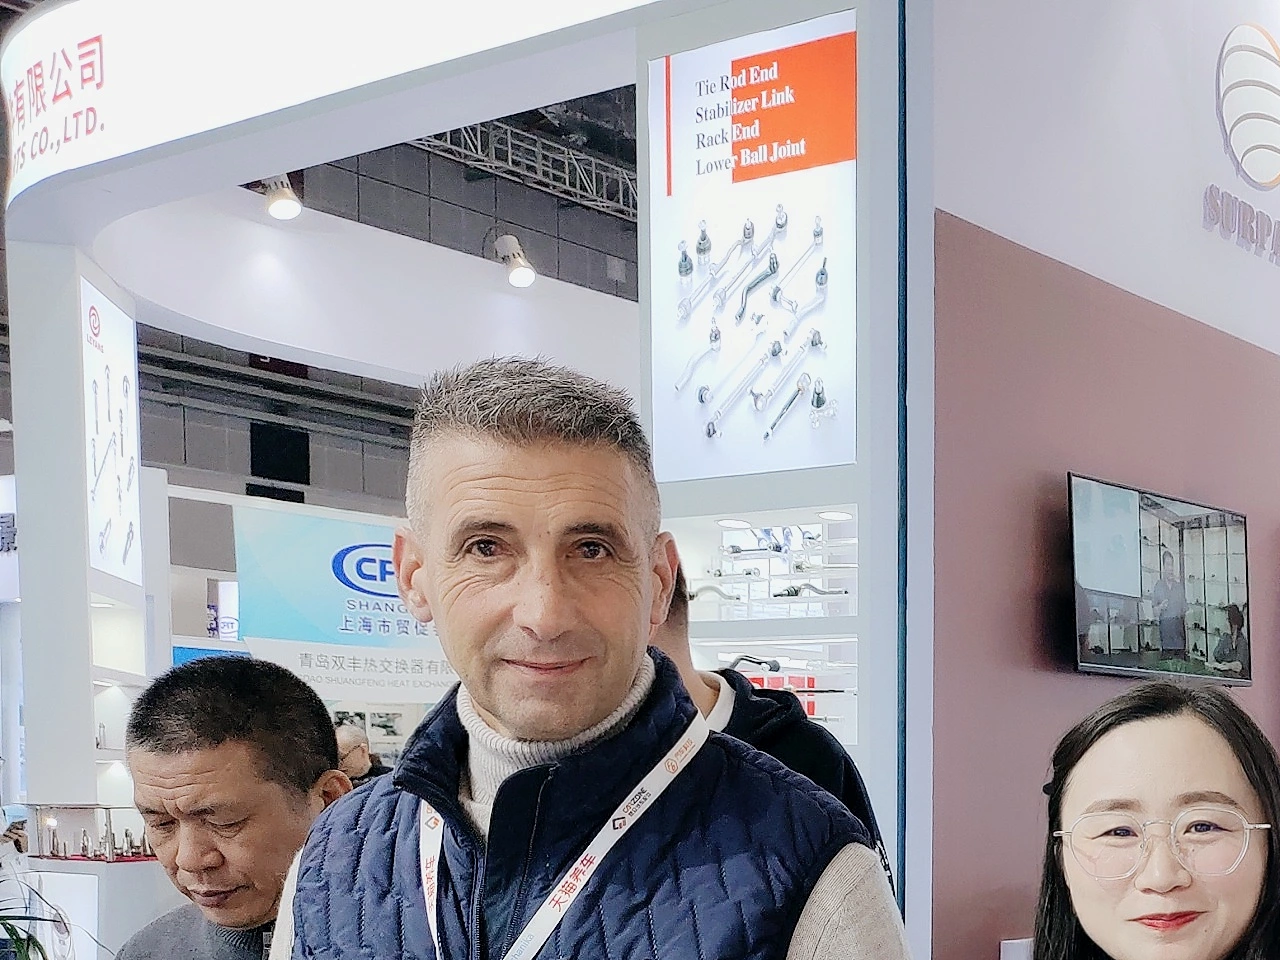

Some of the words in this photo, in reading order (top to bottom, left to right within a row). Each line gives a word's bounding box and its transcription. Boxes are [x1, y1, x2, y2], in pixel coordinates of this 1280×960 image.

[9, 34, 104, 136] 有限公司
[695, 80, 716, 97] Tie
[720, 71, 746, 91] Rod
[749, 61, 778, 84] End
[695, 93, 758, 123] Stabilizer
[761, 86, 795, 108] Link
[695, 128, 729, 149] Rack
[732, 120, 760, 141] End
[695, 154, 737, 175] Lower
[740, 144, 768, 167] Ball
[770, 138, 806, 162] Joint
[356, 558, 395, 581] CP
[347, 600, 408, 614] SHANG
[548, 853, 597, 912] 天猫养车
